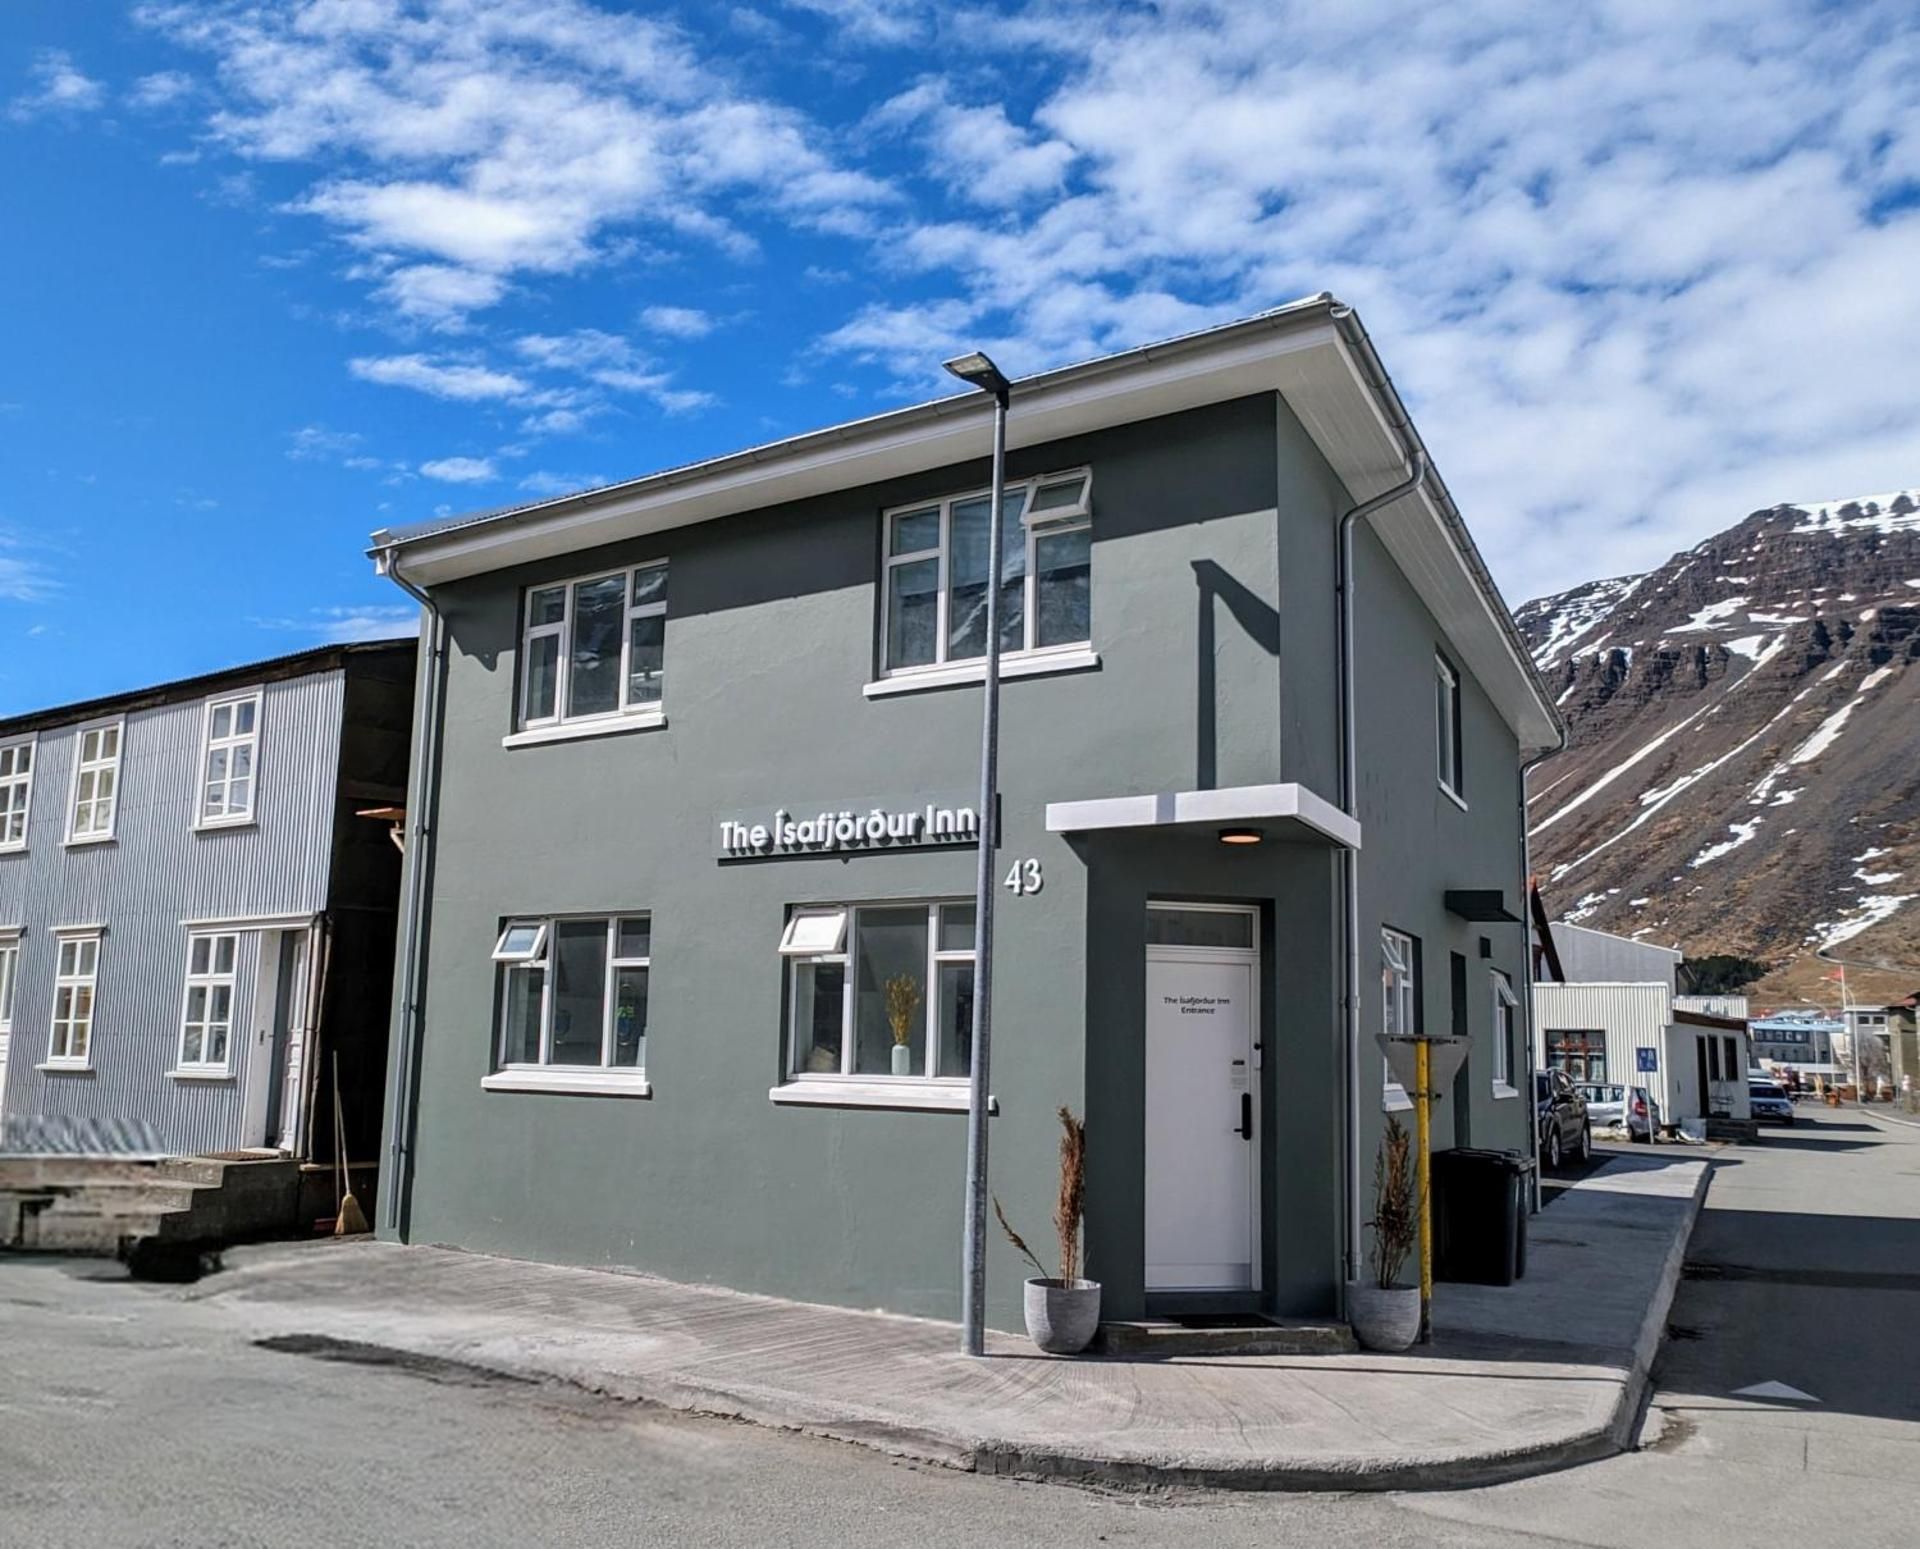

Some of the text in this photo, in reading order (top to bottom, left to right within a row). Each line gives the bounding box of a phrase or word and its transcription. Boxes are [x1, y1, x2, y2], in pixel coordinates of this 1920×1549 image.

[720, 804, 977, 849] The Ísafjörður Inn
[1003, 857, 1043, 894] 43
[1163, 996, 1178, 1005] The
[1180, 1006, 1216, 1015] Entrance
